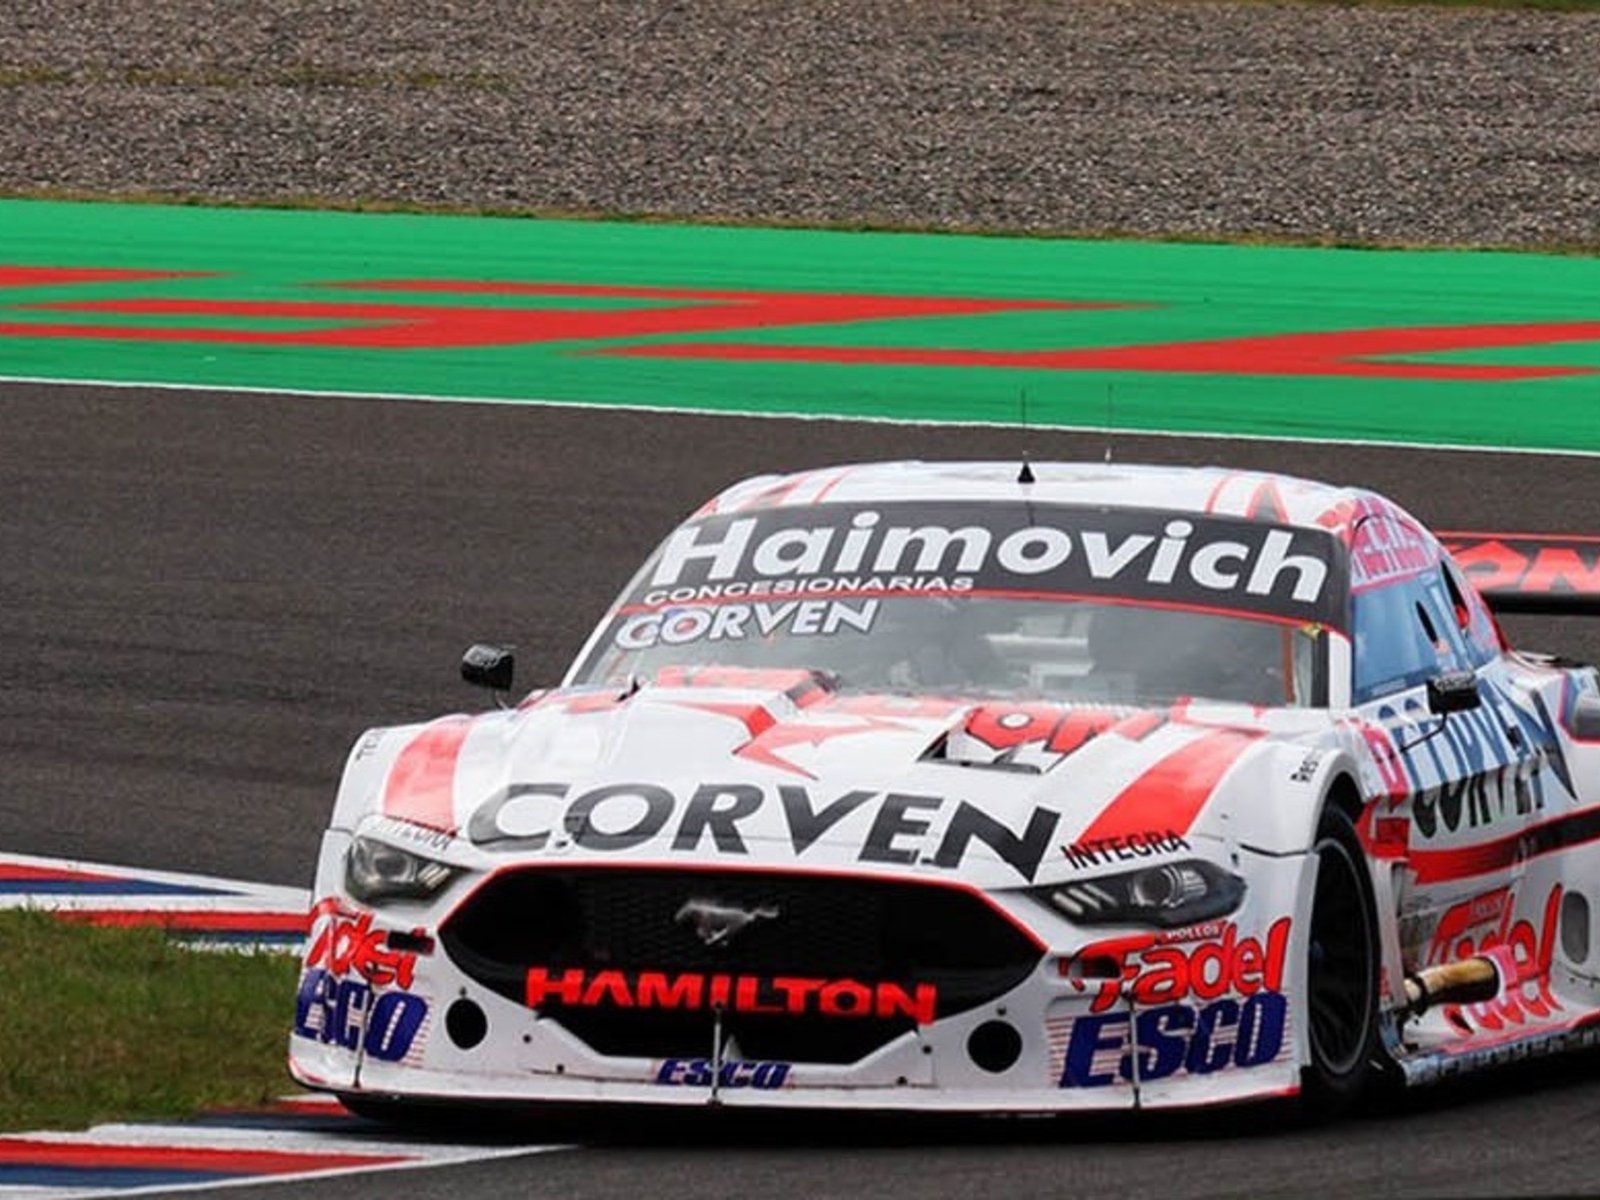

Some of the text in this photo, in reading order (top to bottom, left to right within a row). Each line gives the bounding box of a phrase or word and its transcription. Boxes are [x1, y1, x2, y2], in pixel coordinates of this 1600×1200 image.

[651, 511, 1328, 603] Haimovich
[643, 575, 974, 607] CONCESIONARIAS
[614, 598, 883, 650] CORVEN
[467, 783, 1061, 883] CORVEN
[1060, 829, 1192, 870] INTEGRA
[525, 966, 938, 1026] HAMILTON
[1059, 991, 1288, 1088] ESCO
[655, 1058, 792, 1090] ESCO
